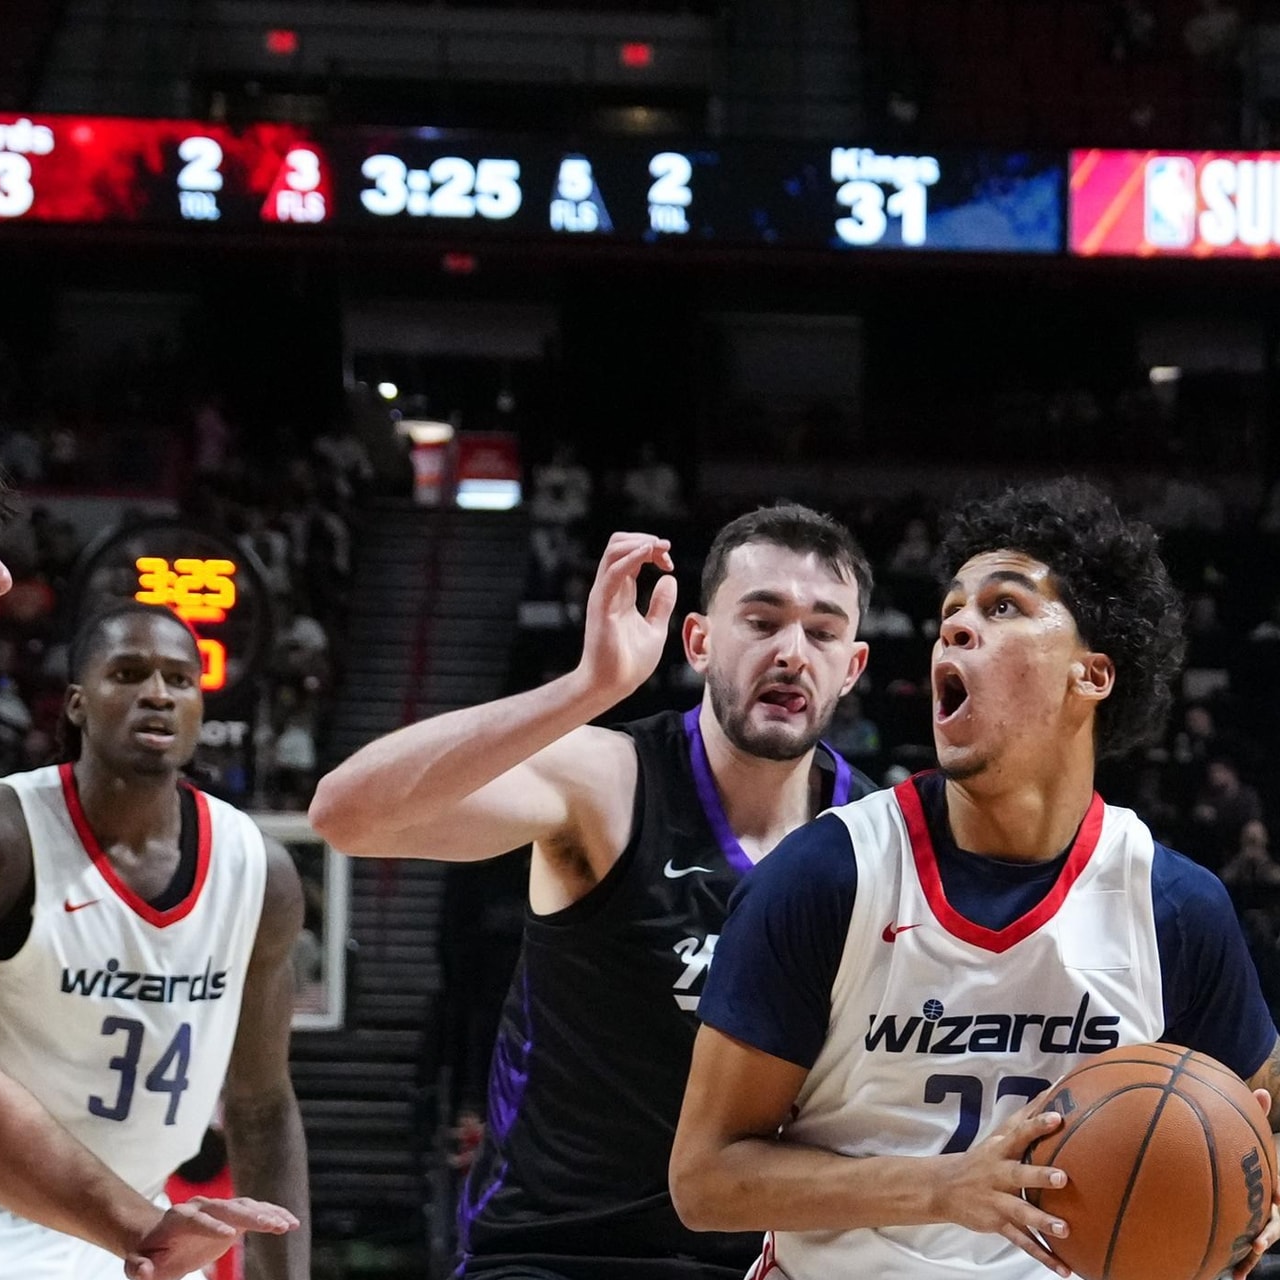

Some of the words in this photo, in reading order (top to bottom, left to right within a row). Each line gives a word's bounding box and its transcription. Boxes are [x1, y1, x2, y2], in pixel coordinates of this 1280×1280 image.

[177, 137, 223, 192] 2
[285, 149, 321, 192] 3
[360, 154, 522, 219] 3:25
[558, 158, 593, 201] 5
[648, 153, 692, 206] 2
[835, 180, 927, 246] 31
[60, 955, 227, 1003] wizards
[864, 990, 1121, 1054] wizards
[87, 1015, 192, 1126] 34
